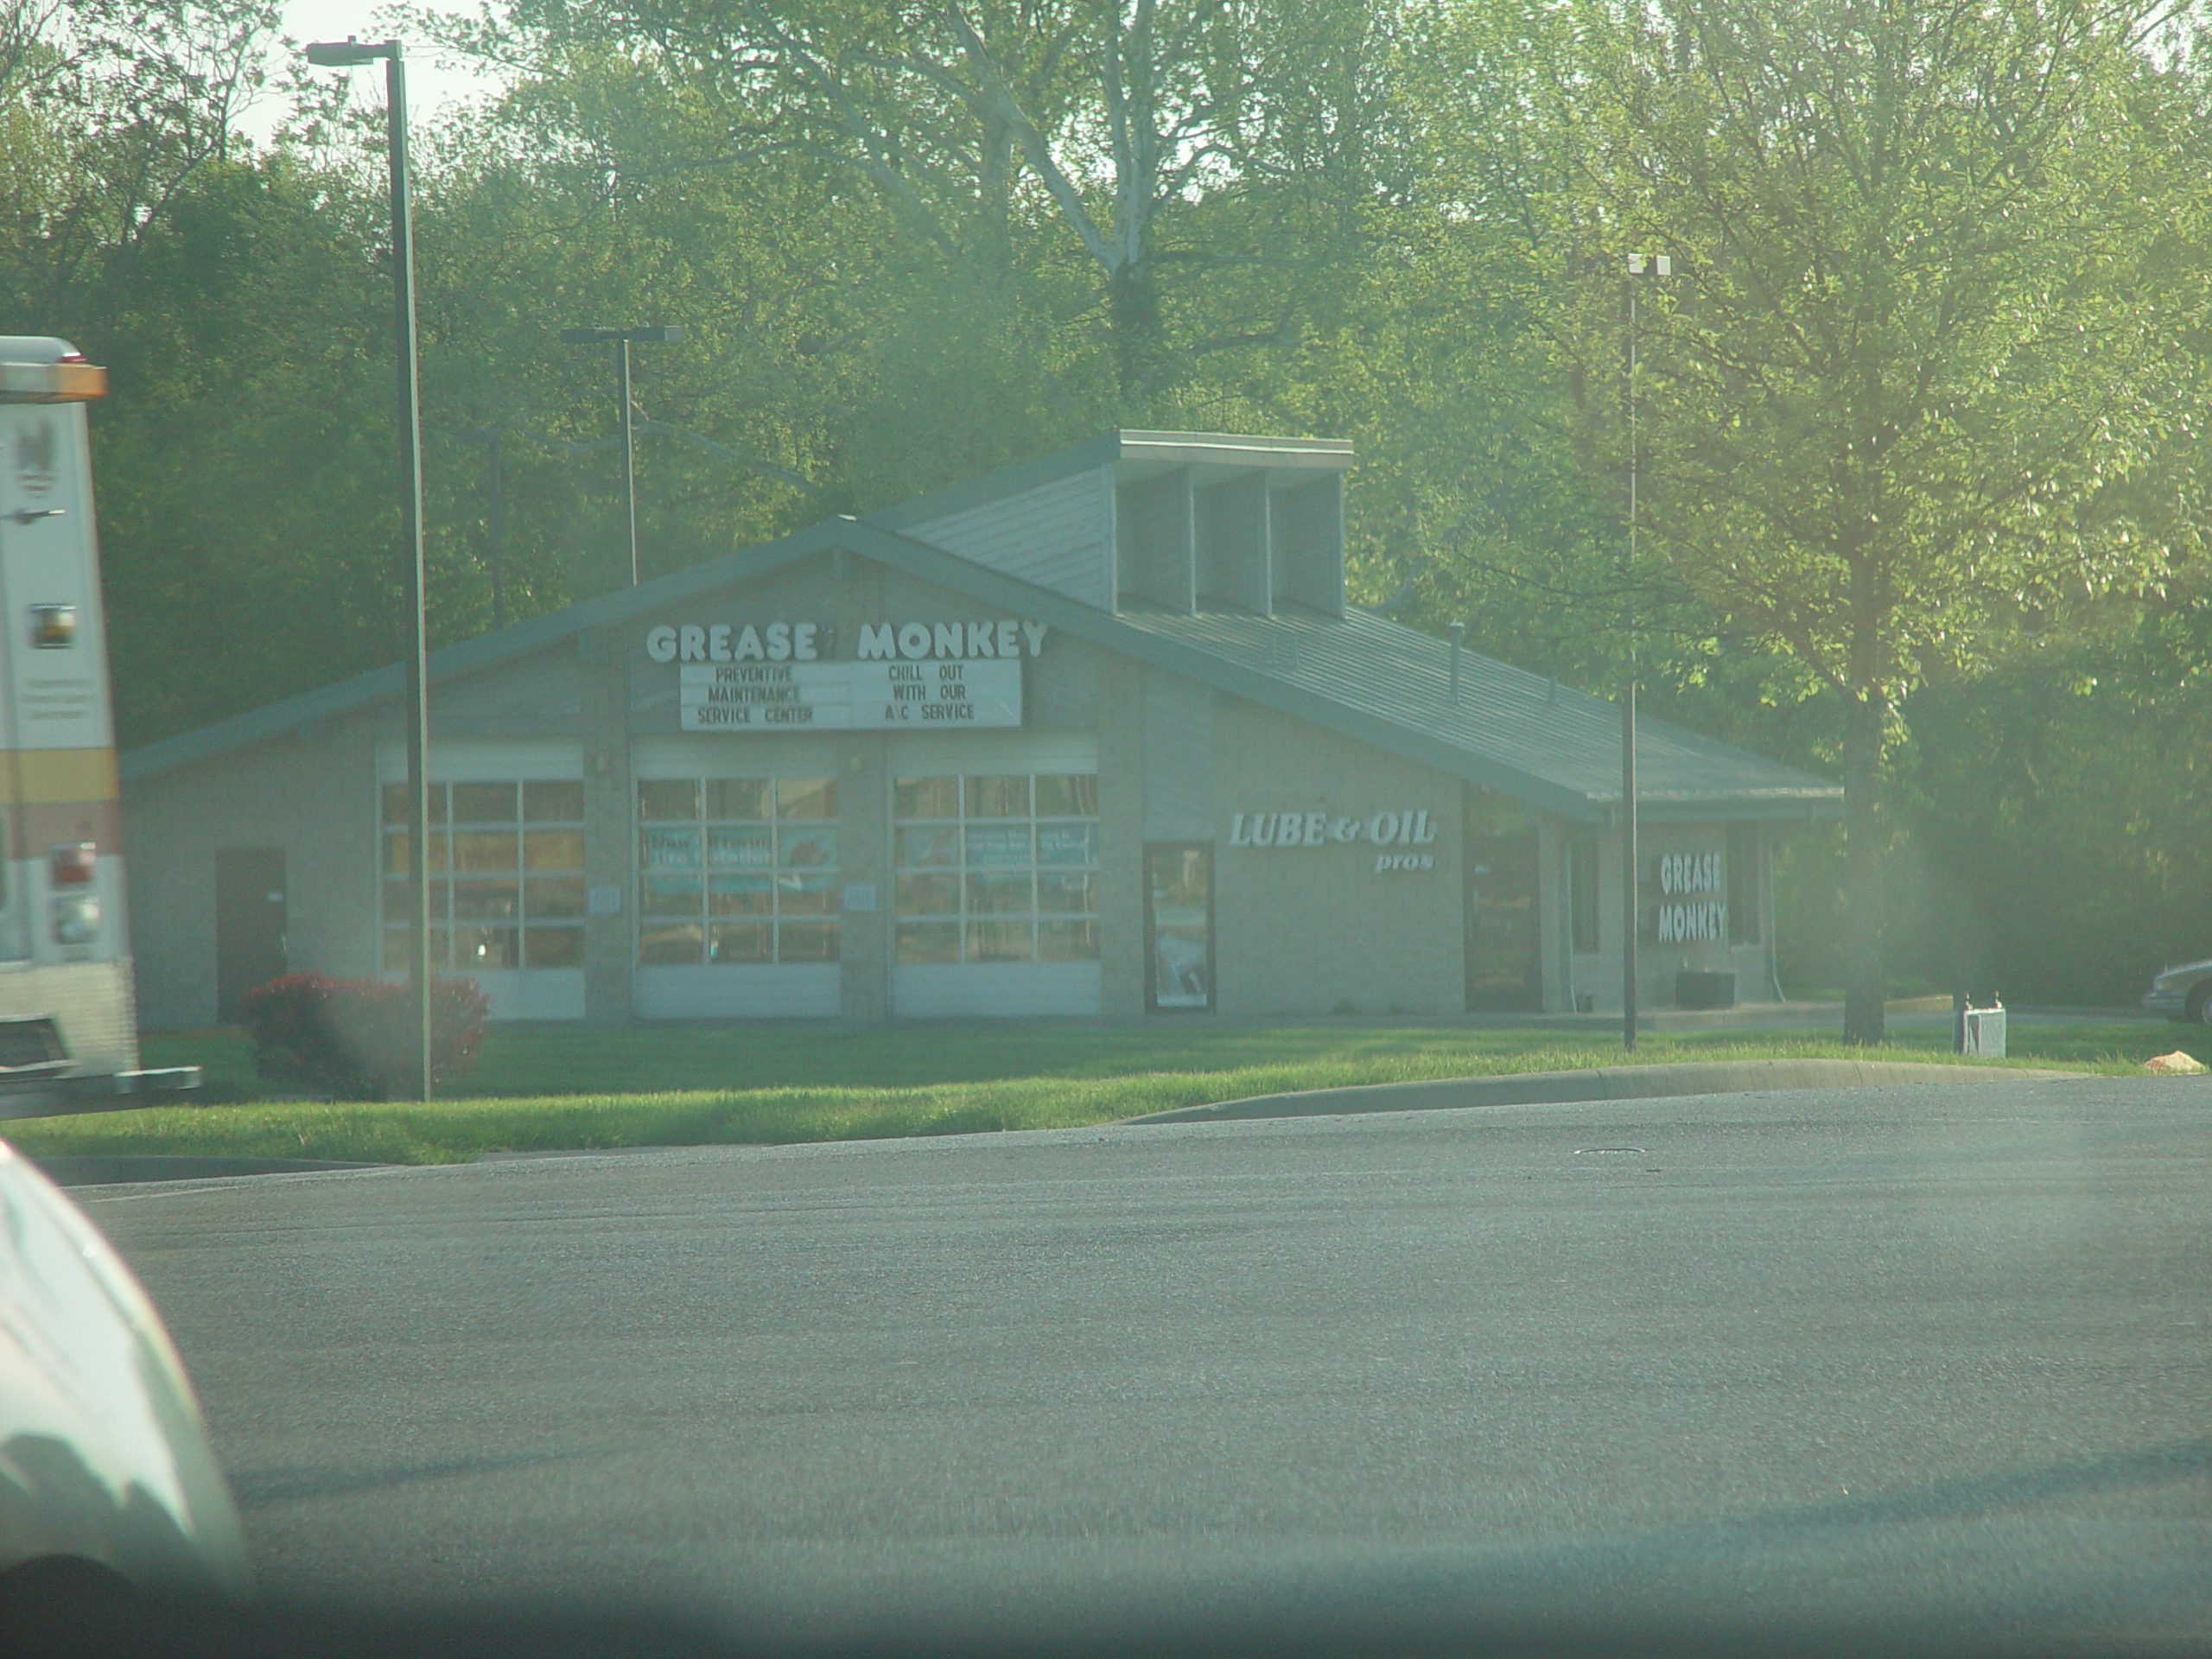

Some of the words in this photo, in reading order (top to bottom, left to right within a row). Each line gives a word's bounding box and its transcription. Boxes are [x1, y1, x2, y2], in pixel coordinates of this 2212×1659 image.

[645, 624, 818, 663] GREASE
[858, 620, 1048, 660] MONKEY
[715, 665, 792, 683] PREVENTIVE
[888, 665, 923, 681] CHILL
[939, 665, 964, 680] OUT
[708, 686, 801, 703] MAINTENANCE
[893, 684, 926, 701] WITH
[940, 684, 966, 700] OUR
[697, 706, 751, 723] SERVICE
[765, 705, 813, 722] CENTER
[921, 703, 975, 720] SERVICE
[1230, 812, 1327, 847] LUBE
[1334, 817, 1360, 843] &
[1370, 810, 1435, 846] OIL
[1375, 854, 1434, 874] pros
[1661, 853, 1720, 894] GREASE
[1659, 902, 1726, 943] MONKEY
